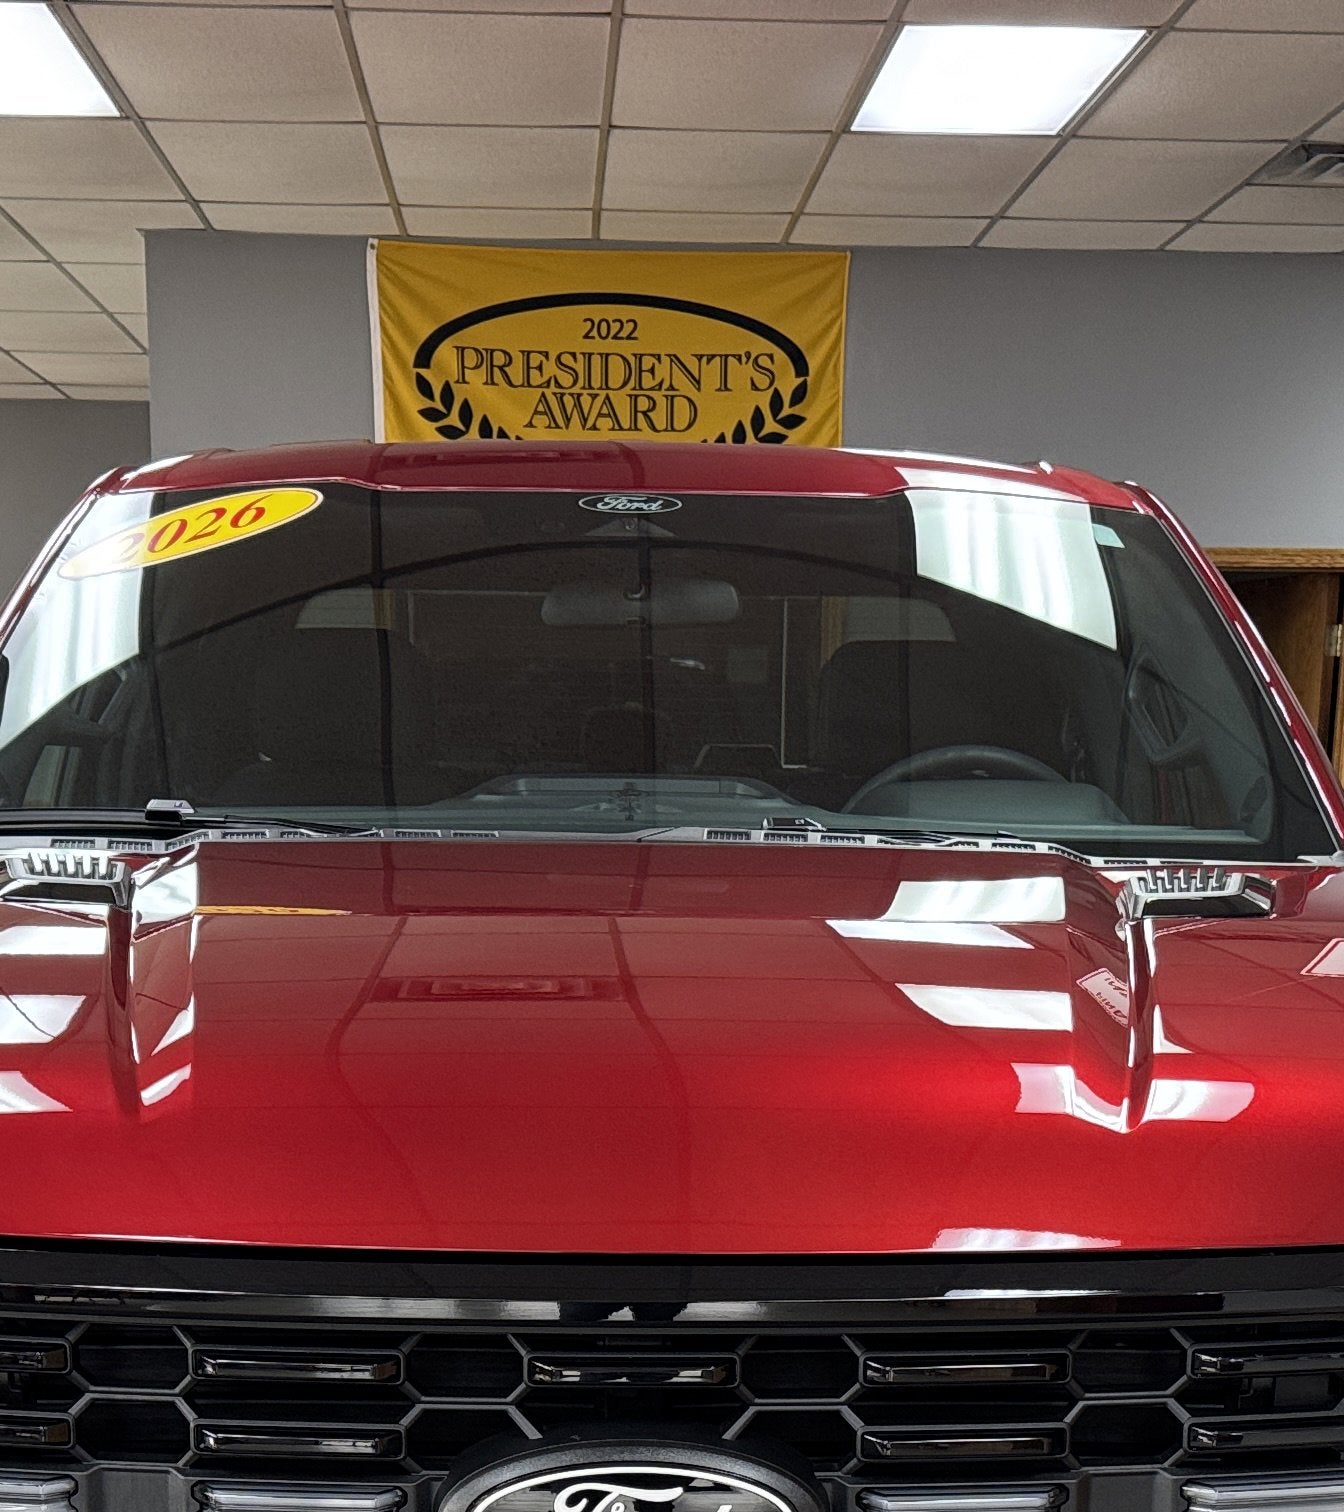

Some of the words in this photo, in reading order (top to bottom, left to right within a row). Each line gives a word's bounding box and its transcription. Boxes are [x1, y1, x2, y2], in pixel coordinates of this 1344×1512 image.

[582, 317, 639, 341] 2022
[452, 345, 776, 393] PRESIDENT'S
[523, 391, 699, 433] AWARD
[597, 496, 664, 510] Ford
[112, 493, 273, 562] 2026
